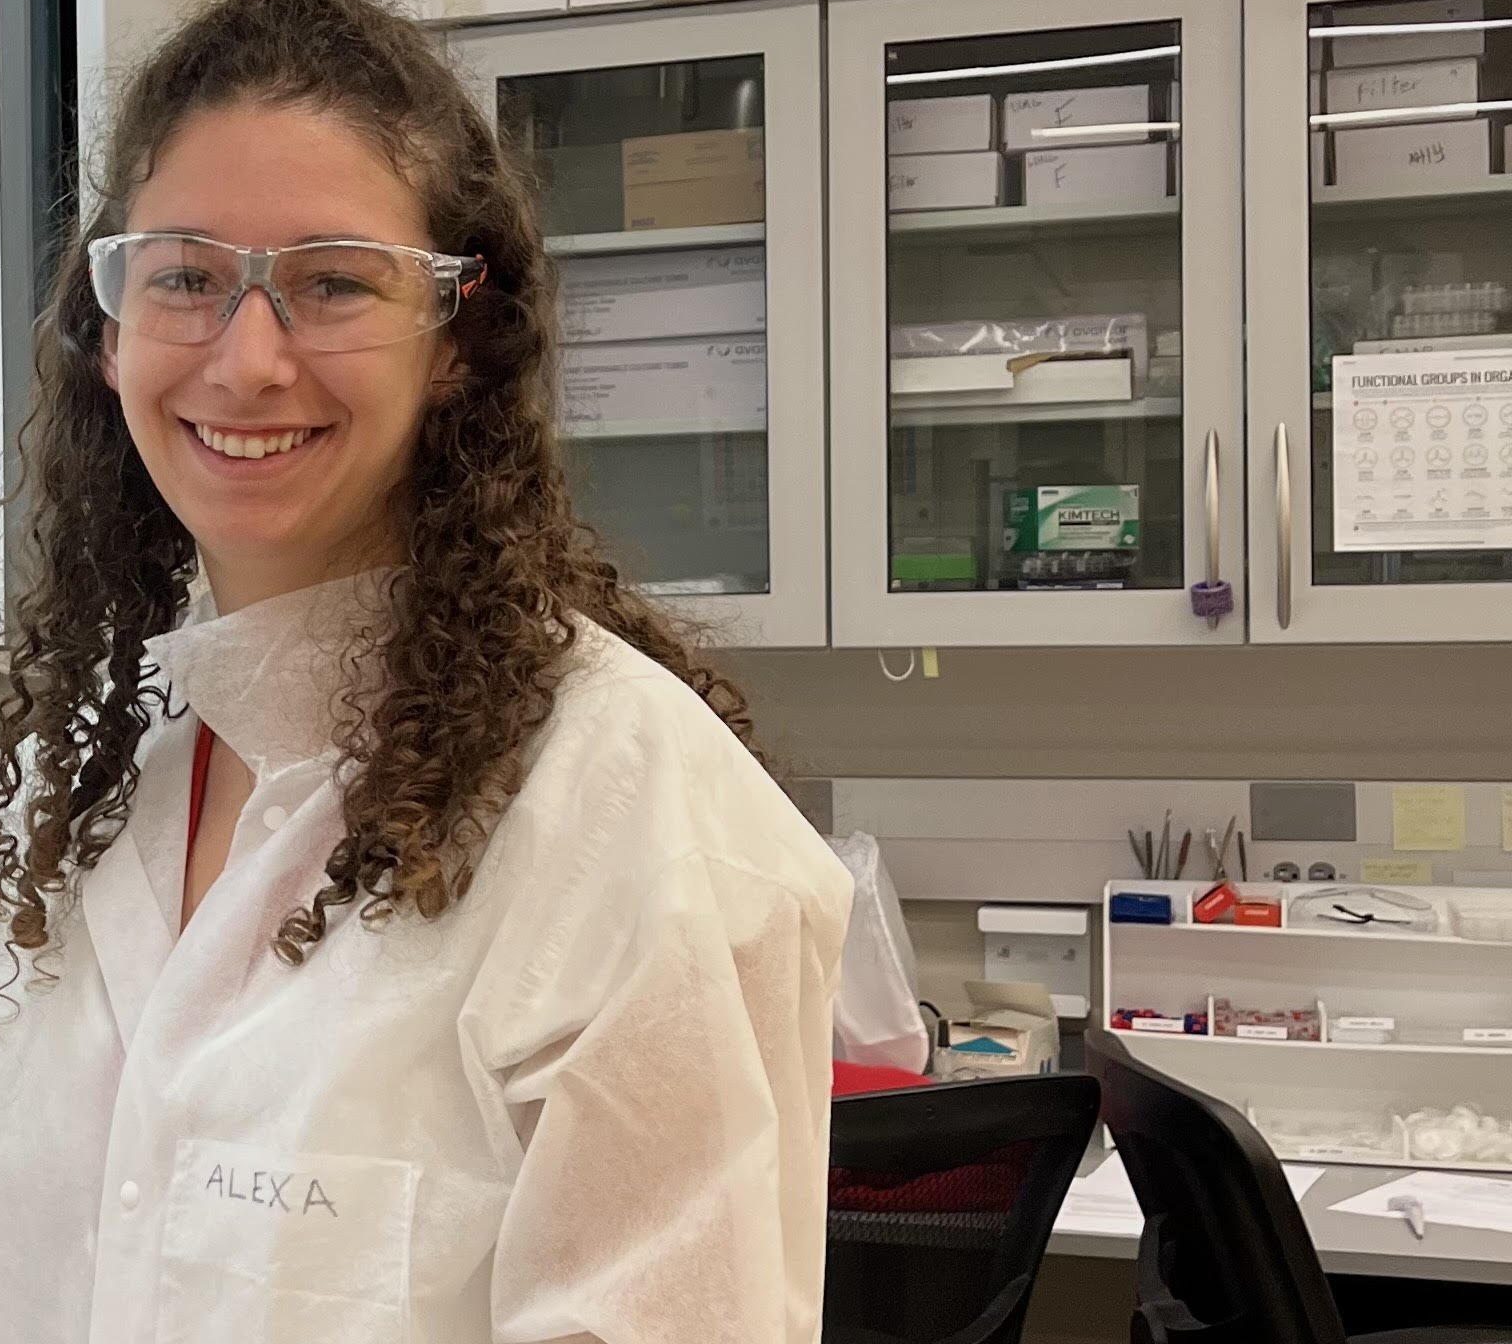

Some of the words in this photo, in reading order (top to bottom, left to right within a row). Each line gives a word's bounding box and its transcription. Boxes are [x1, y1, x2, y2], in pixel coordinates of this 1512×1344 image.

[1351, 374, 1418, 389] FUNCTIONAL
[1420, 371, 1468, 386] GROUPS
[1470, 370, 1482, 384] IN
[1057, 509, 1120, 522] KIMTECH
[205, 1162, 340, 1219] ALEXA
